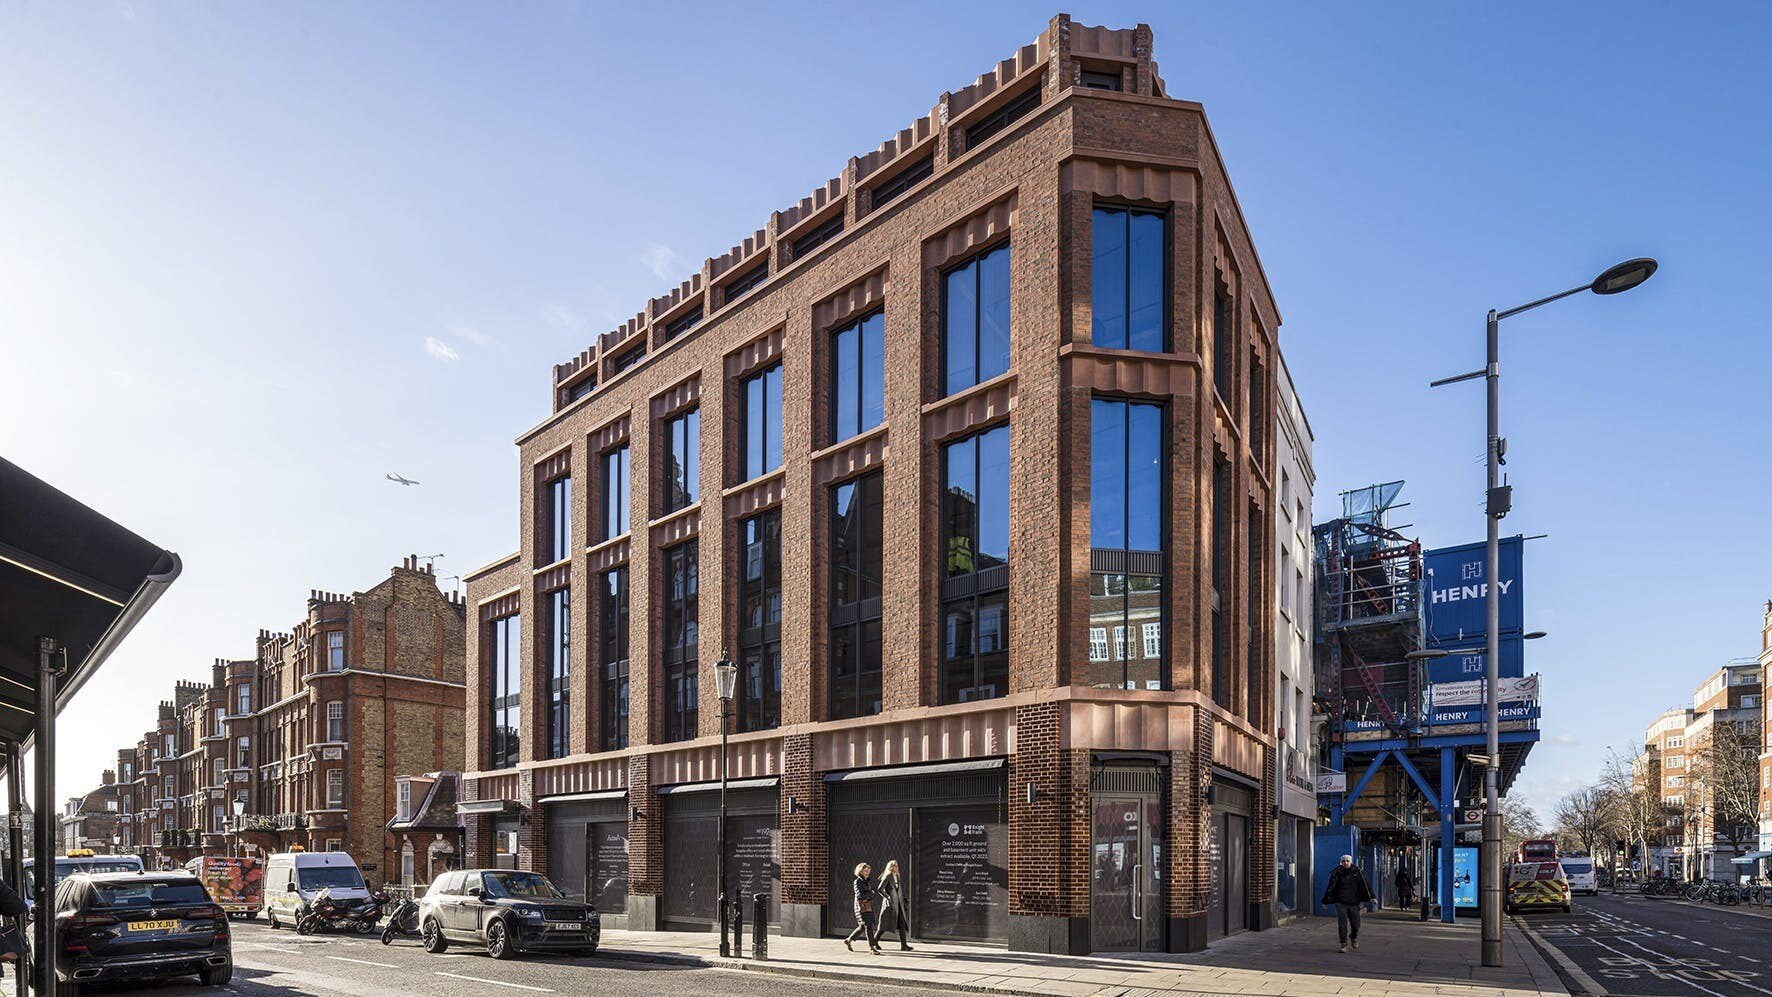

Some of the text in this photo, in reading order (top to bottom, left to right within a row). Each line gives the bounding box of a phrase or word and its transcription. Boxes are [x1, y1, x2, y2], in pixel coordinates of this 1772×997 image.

[1435, 688, 1458, 697] respect
[1459, 688, 1470, 696] the
[1435, 711, 1468, 721] HENRY
[1498, 707, 1530, 717] HENRY
[131, 920, 174, 930] LL70 XJU
[1598, 957, 1720, 967] BUS
[1599, 968, 1761, 982] STOP
